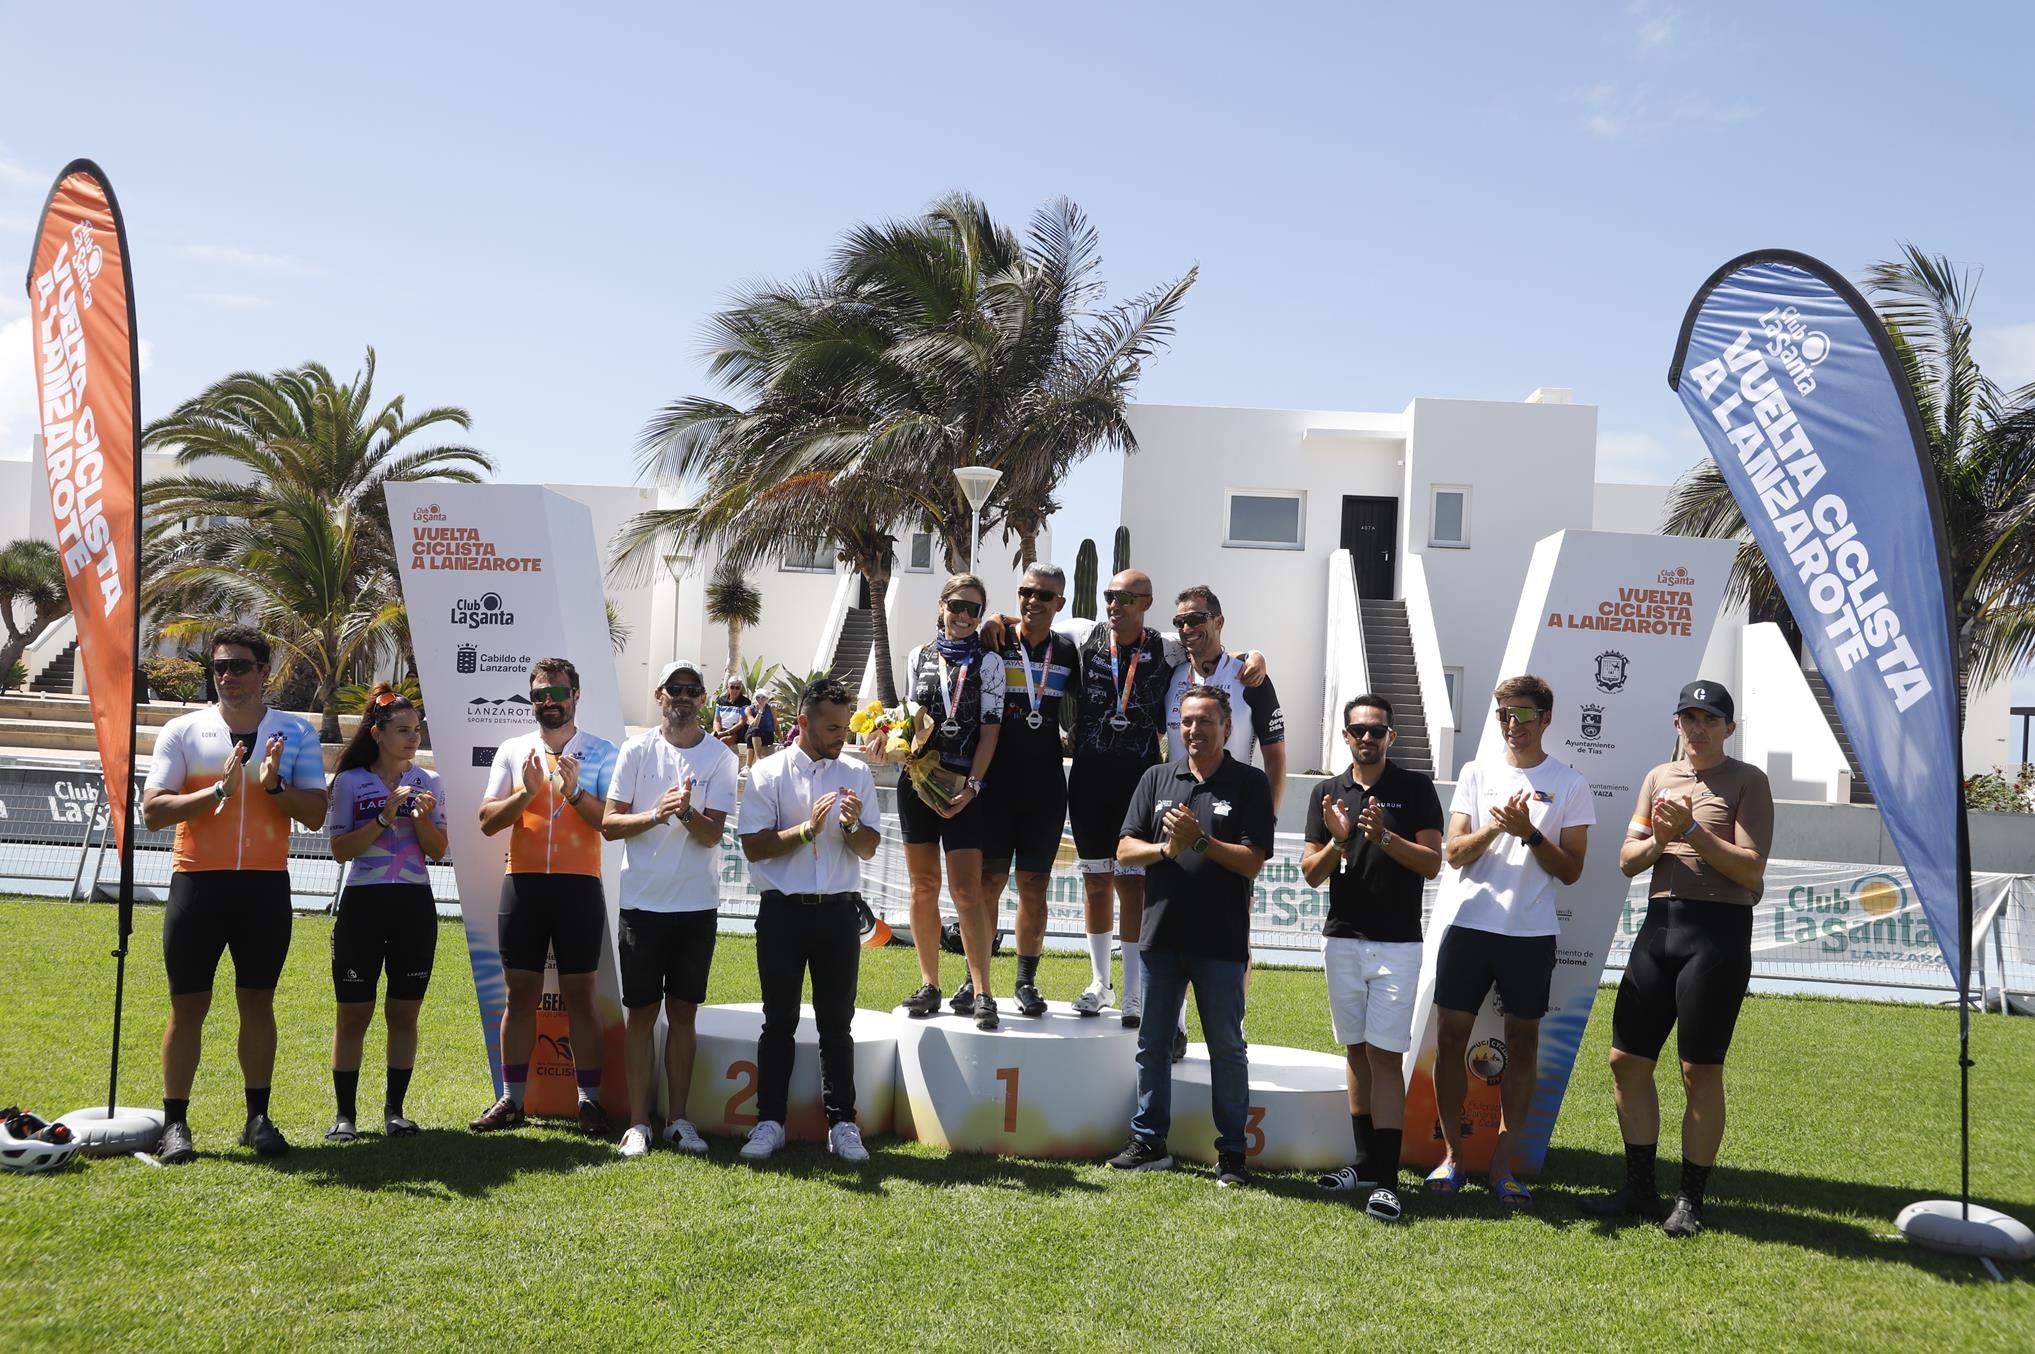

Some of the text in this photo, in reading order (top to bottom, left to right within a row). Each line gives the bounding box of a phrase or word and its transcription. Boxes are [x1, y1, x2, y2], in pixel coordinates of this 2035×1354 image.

[1781, 306, 1808, 340] Club
[1758, 306, 1817, 397] LaSanta
[35, 274, 91, 578] A LANZAROTE
[50, 242, 124, 618] VUELTA CICLISTA
[416, 506, 430, 514] Club
[1688, 357, 1870, 674] A LANZAROTE
[1722, 329, 1933, 714] VUELTA CICLISTA
[413, 527, 480, 541] VUELTA
[412, 541, 496, 556] CICLISTA
[411, 556, 542, 572] A LANZAROTE
[1660, 569, 1675, 577] Club
[456, 598, 481, 611] Club
[1618, 587, 1693, 606] VUELTA
[1598, 601, 1692, 621] CICLISTA
[1547, 613, 1692, 637] A LANZAROTE
[480, 653, 531, 663] Cabildo de
[480, 663, 527, 673] Lanzarote
[1693, 688, 1706, 700] G
[1564, 739, 1616, 749] Ayuntamiento
[54, 780, 100, 801] Club
[1589, 783, 1629, 792] yuntamiento
[1788, 885, 1850, 915] Club
[1584, 950, 1594, 958] de
[536, 1066, 576, 1077] CICLIS
[723, 1060, 759, 1126] 2
[996, 1066, 1019, 1134] 1
[1246, 1106, 1266, 1157] 3
